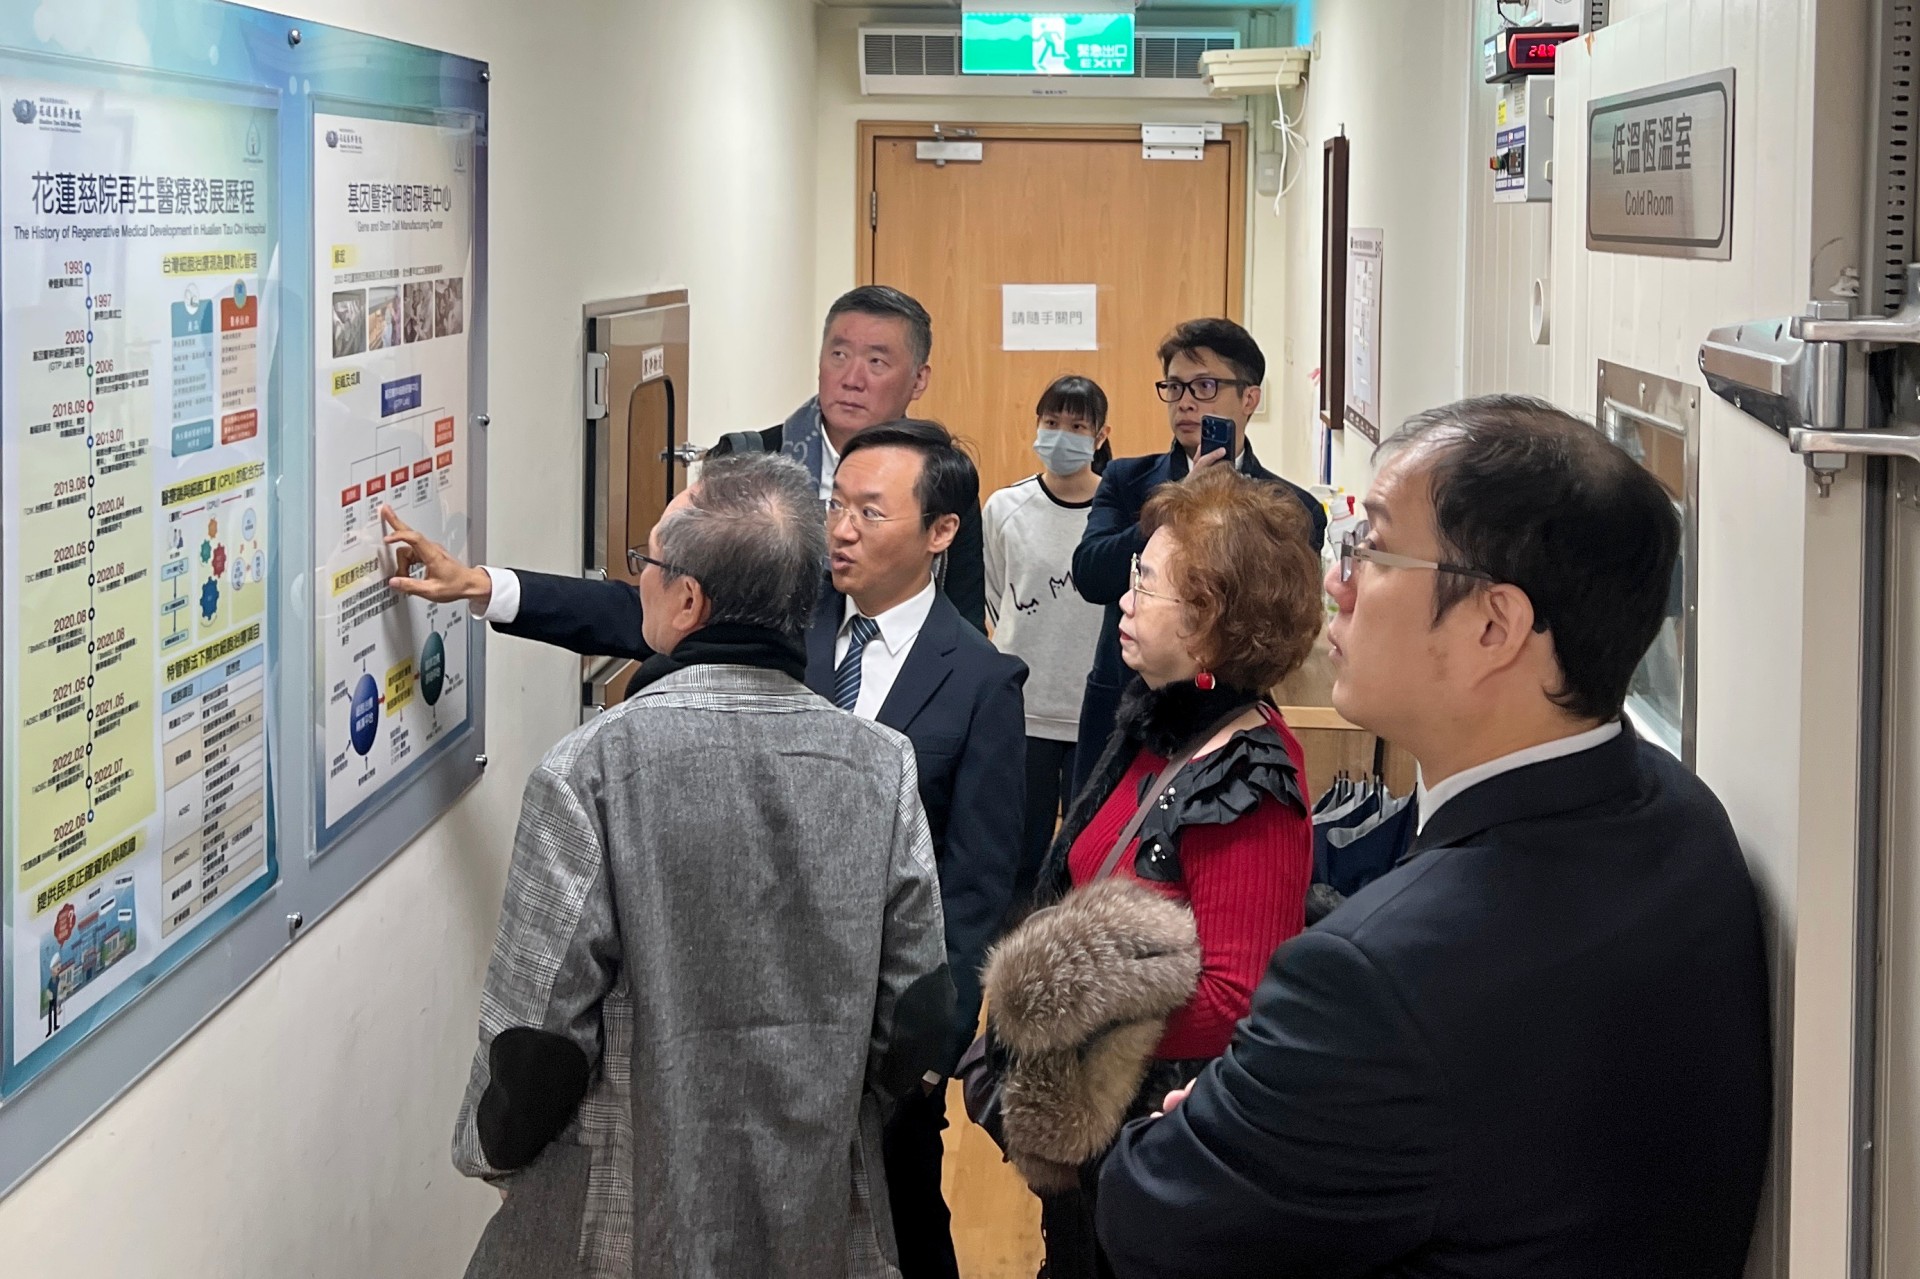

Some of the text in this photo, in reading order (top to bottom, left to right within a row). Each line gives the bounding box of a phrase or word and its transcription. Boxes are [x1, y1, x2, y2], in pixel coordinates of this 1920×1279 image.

[1077, 44, 1127, 58] 緊急出口
[1080, 58, 1125, 69] EXIT
[31, 170, 255, 215] 花蓮慈院再生醫療發展歷程
[1625, 189, 1674, 216] Cold Room
[14, 225, 30, 240] The
[31, 225, 60, 242] History
[61, 225, 70, 239] of
[71, 225, 120, 242] Regenerative
[121, 224, 148, 238] Medical
[150, 224, 192, 239] Development
[64, 261, 83, 275] 1993
[94, 294, 112, 308] 1997
[1011, 310, 1084, 325] 請隨手關門
[65, 330, 85, 345] 2003
[95, 360, 113, 374] 2006
[52, 399, 85, 418] 2018.09
[95, 428, 124, 446] 2019.01
[96, 496, 125, 516] 2020.04
[53, 541, 86, 563] 2020.05
[52, 676, 86, 702] 2021.05
[52, 745, 85, 773] 2022.02
[94, 757, 124, 785] 2022.07
